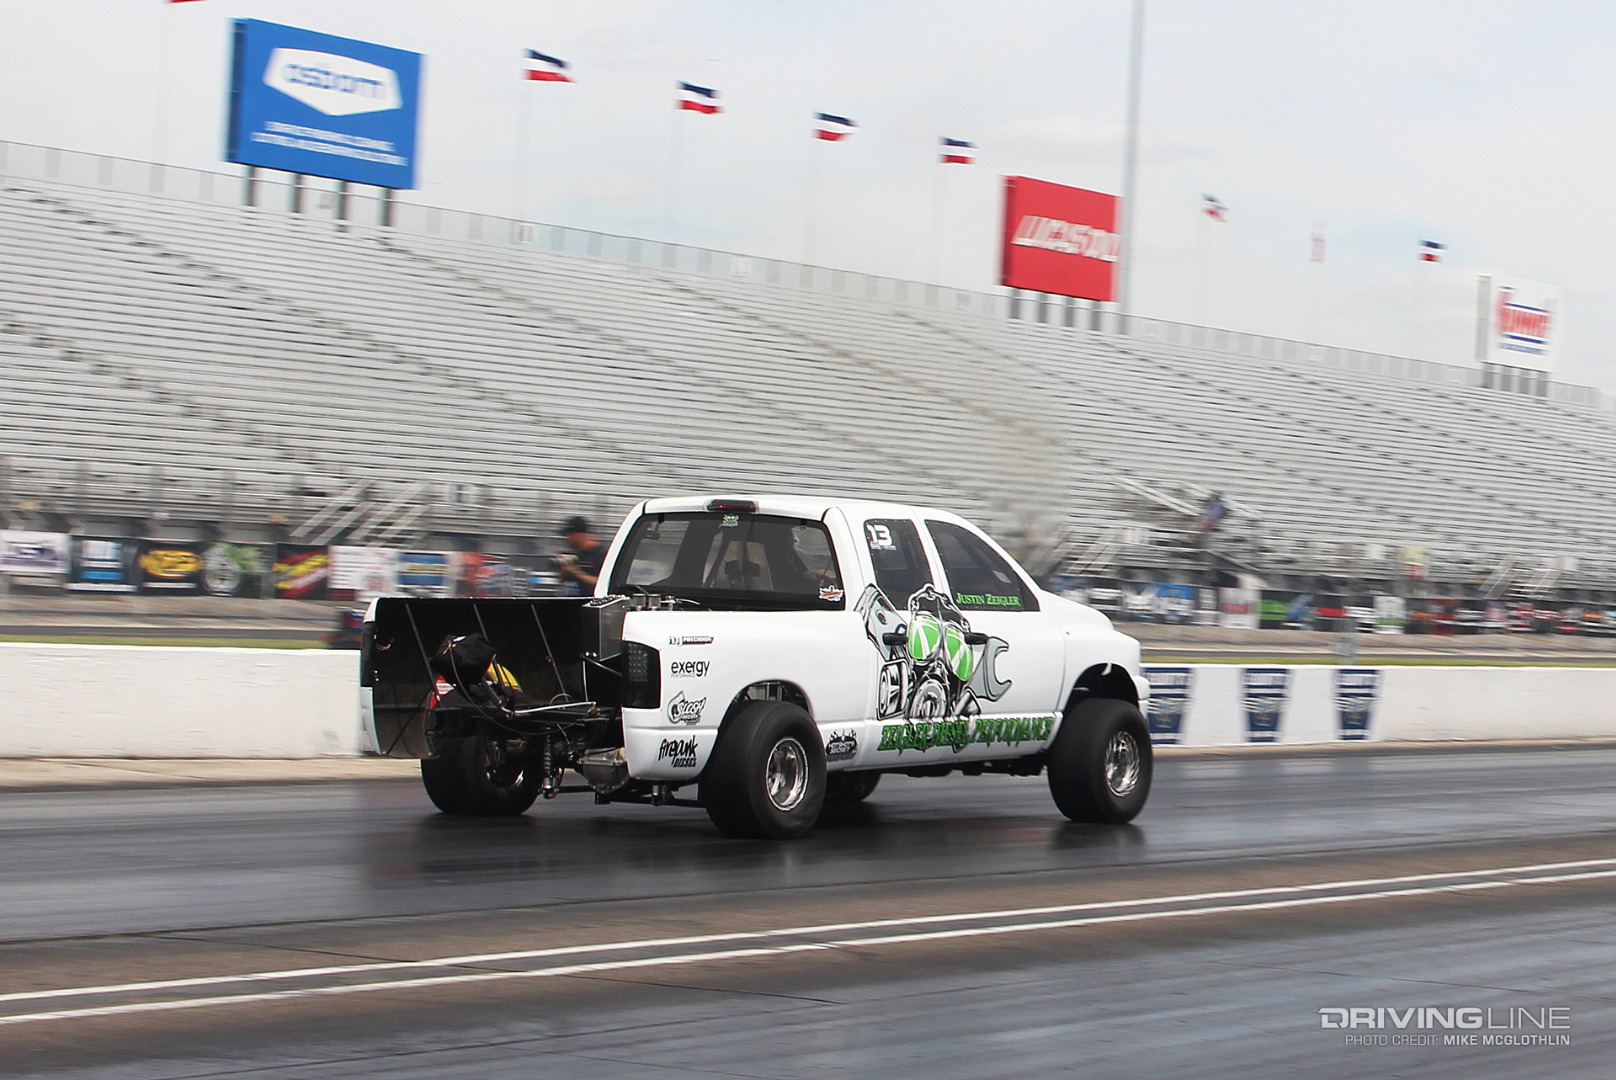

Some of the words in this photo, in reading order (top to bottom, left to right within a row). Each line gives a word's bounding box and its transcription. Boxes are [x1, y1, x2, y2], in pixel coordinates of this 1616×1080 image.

[866, 524, 893, 546] 13
[956, 592, 985, 605] JUSTIN
[985, 593, 1022, 607] ZEIGLER
[671, 661, 710, 677] exergy
[673, 757, 698, 768] DIESEL
